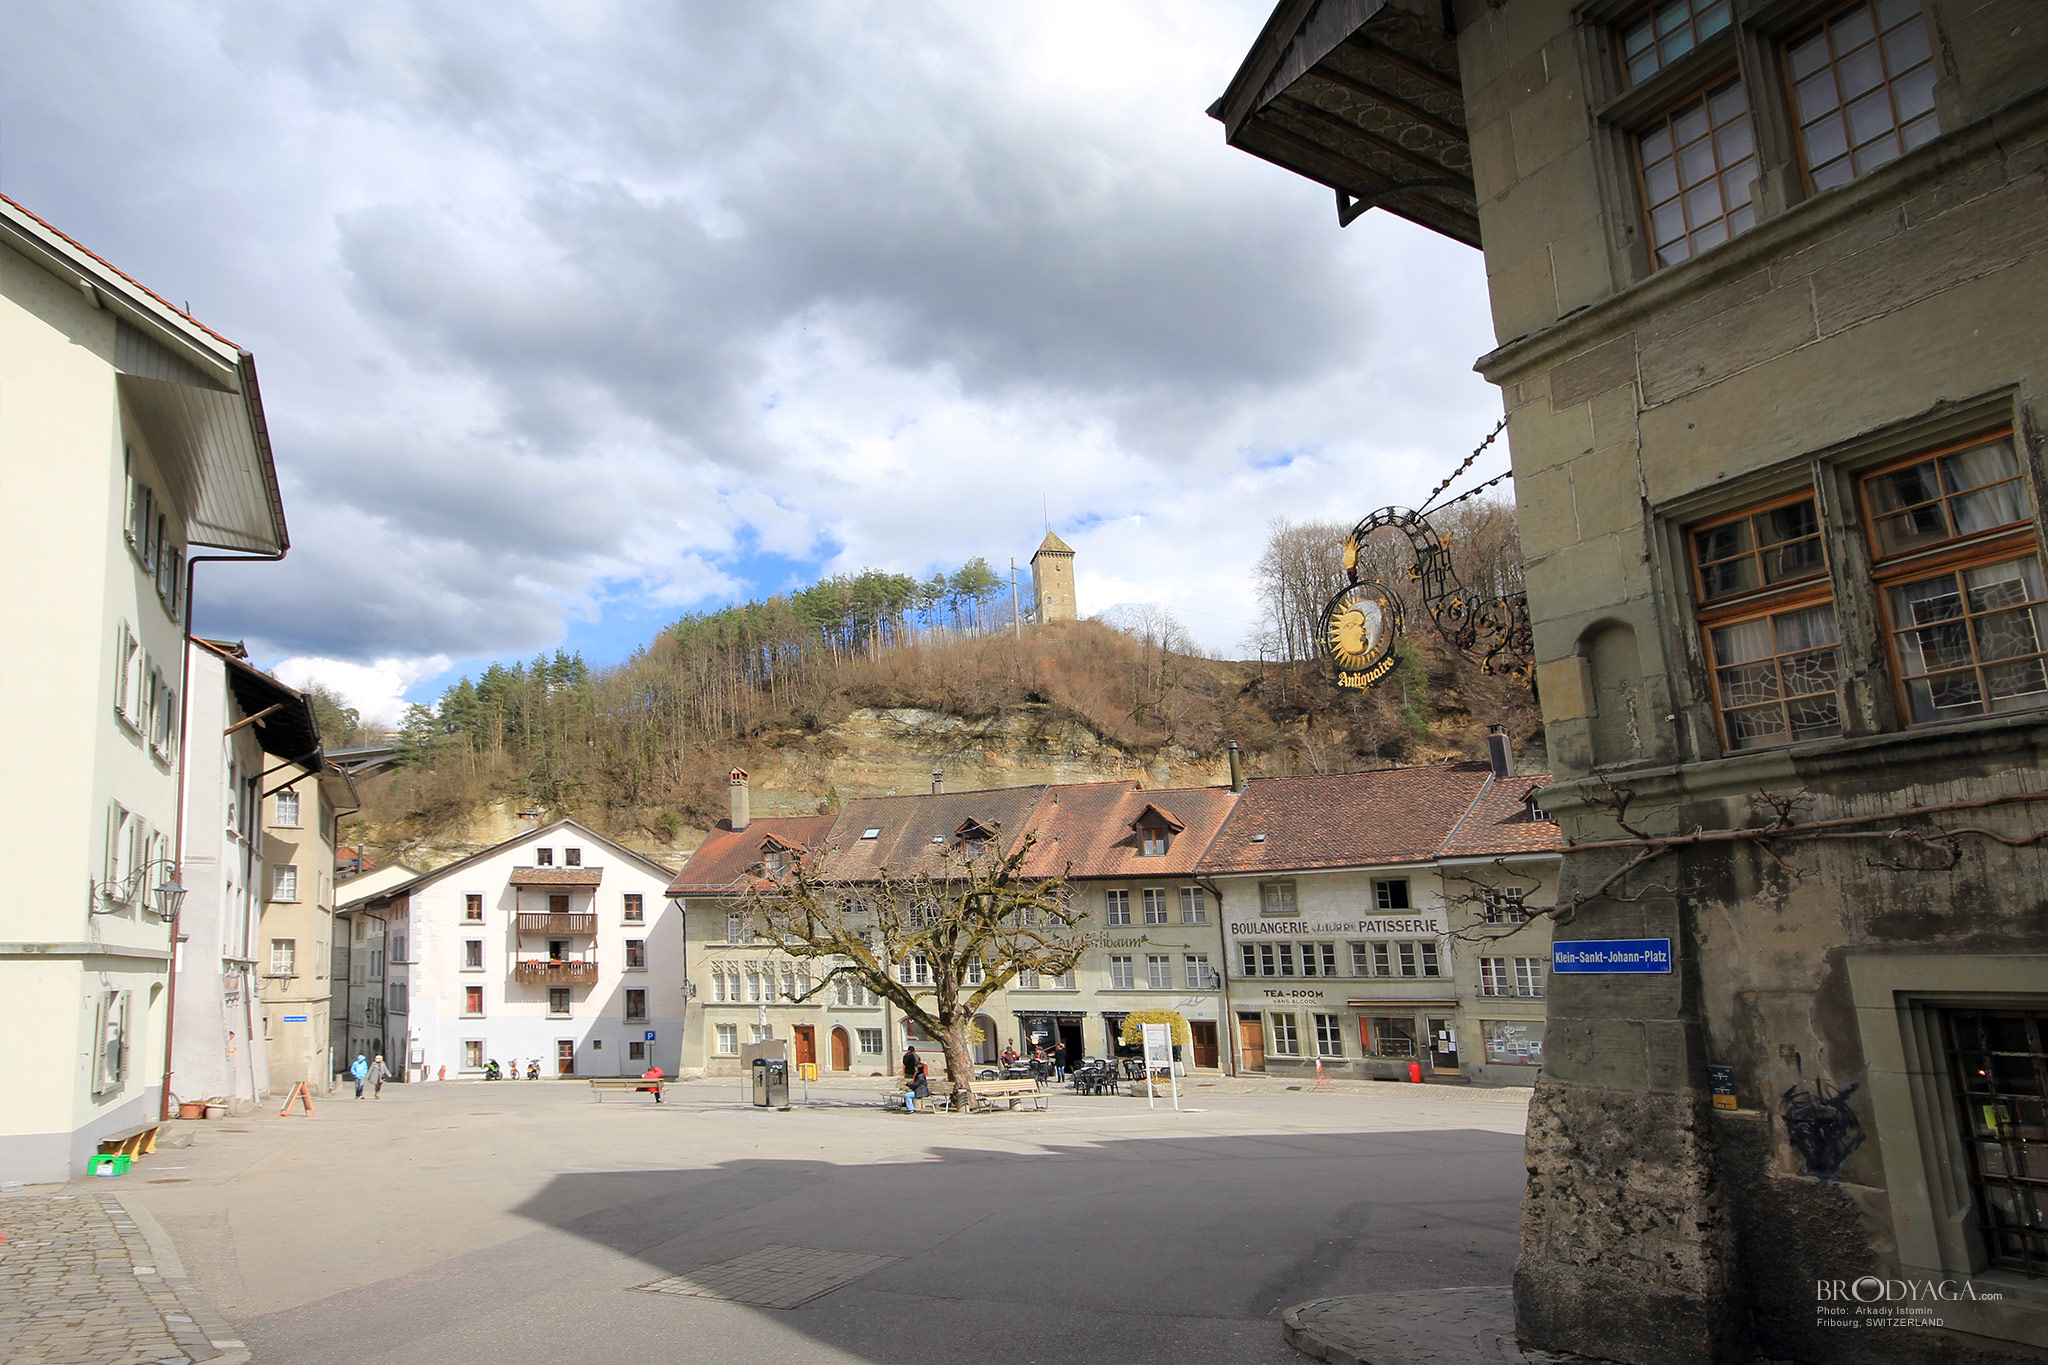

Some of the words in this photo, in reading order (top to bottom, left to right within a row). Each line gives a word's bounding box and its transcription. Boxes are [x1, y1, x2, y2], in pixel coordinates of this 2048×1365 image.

[1337, 656, 1395, 689] Antiquaire
[1231, 922, 1310, 934] BOULANGERIE
[1359, 919, 1439, 933] PATISSERIE
[1555, 950, 1667, 963] Klein-Sankt-Johann-Platz
